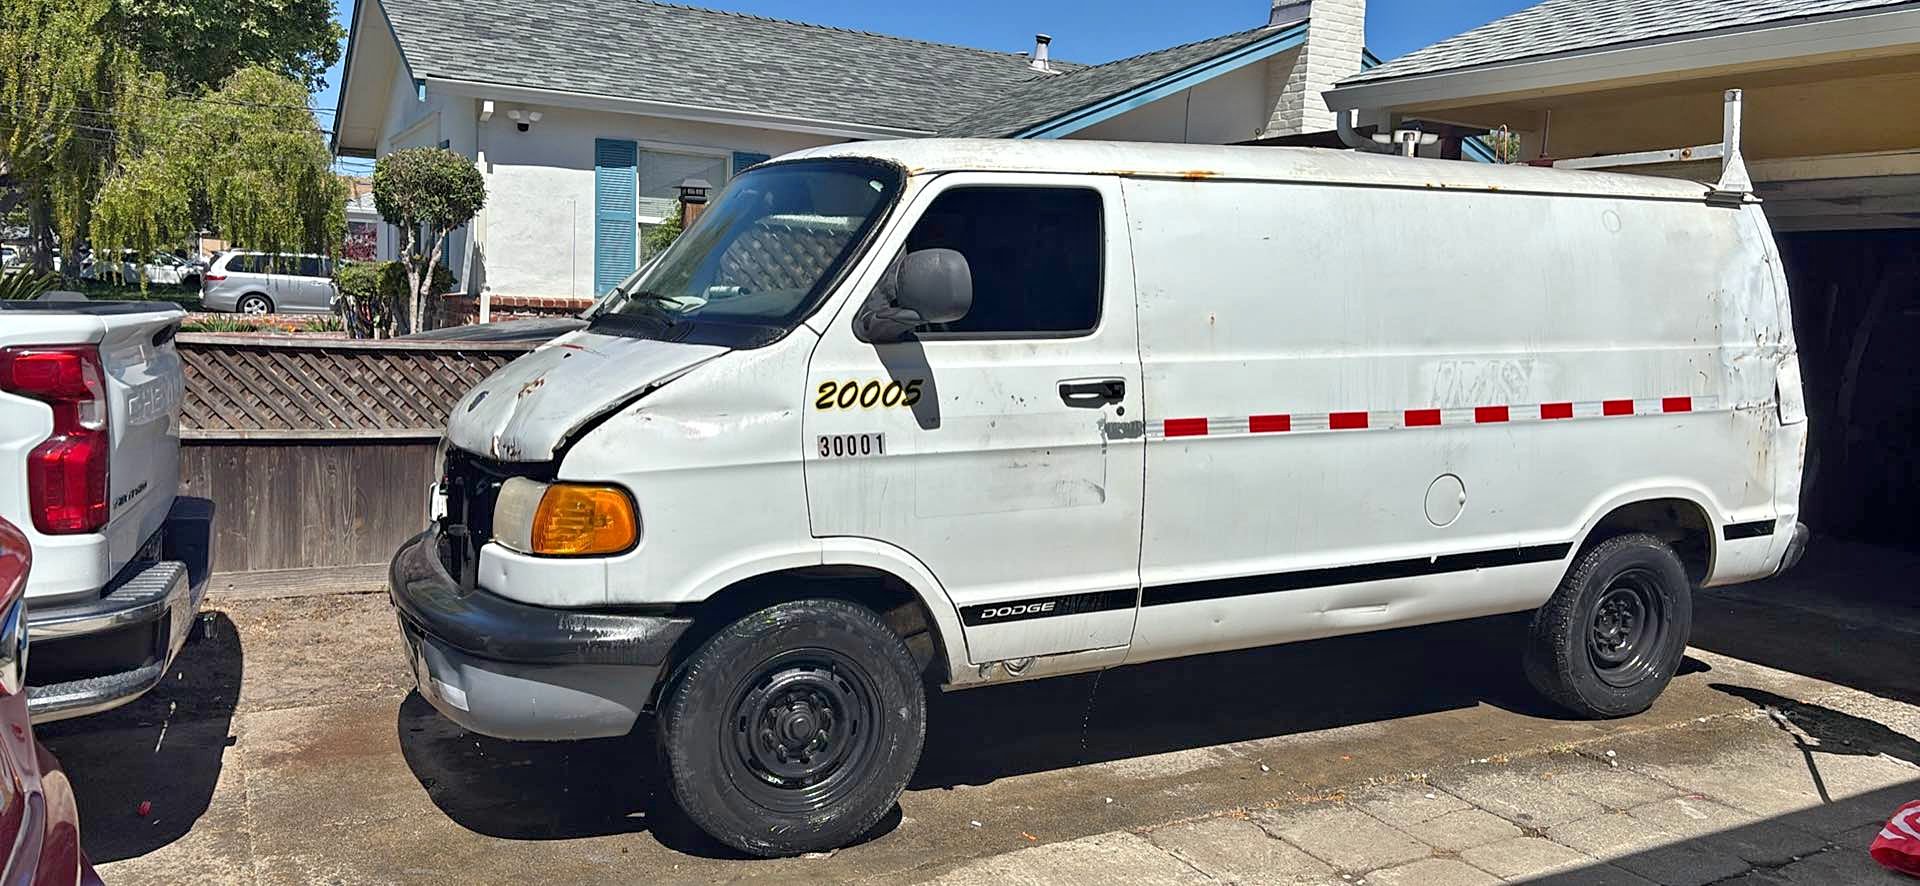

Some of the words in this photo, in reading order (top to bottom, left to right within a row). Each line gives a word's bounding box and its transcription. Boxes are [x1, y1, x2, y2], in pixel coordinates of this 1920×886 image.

[815, 379, 924, 410] 20005
[819, 434, 883, 457] 30001
[981, 601, 1056, 619] DODGE
